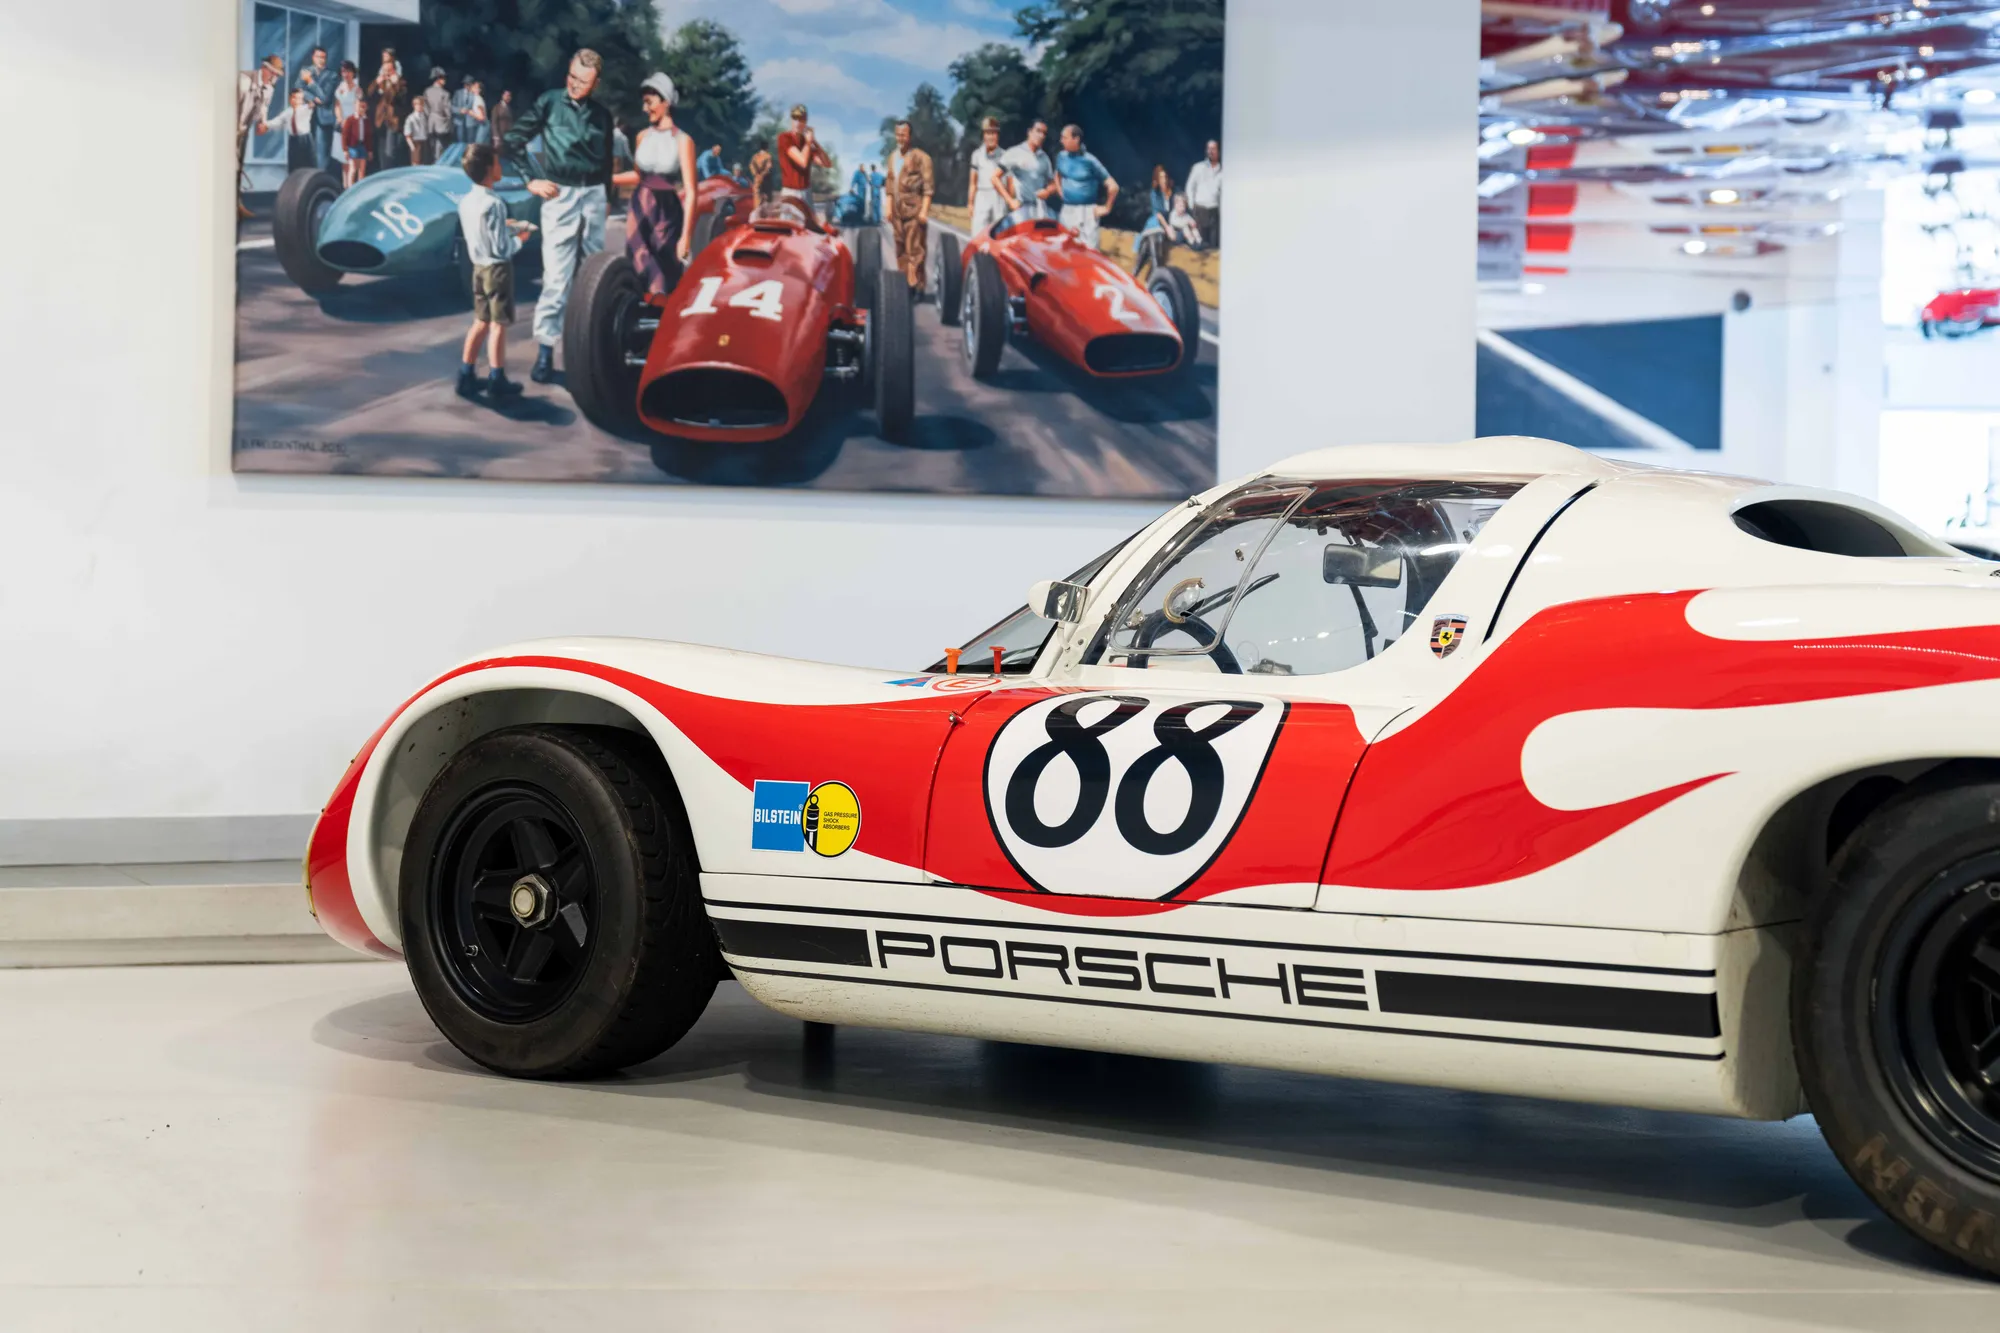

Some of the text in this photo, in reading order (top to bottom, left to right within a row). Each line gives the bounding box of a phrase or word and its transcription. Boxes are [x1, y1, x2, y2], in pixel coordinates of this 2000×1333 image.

[370, 201, 424, 240] 18
[680, 276, 784, 322] 14
[1094, 284, 1139, 320] 2
[1005, 694, 1264, 856] 88
[754, 808, 801, 825] BILSTEIN
[875, 929, 1370, 1011] PORSCHE
